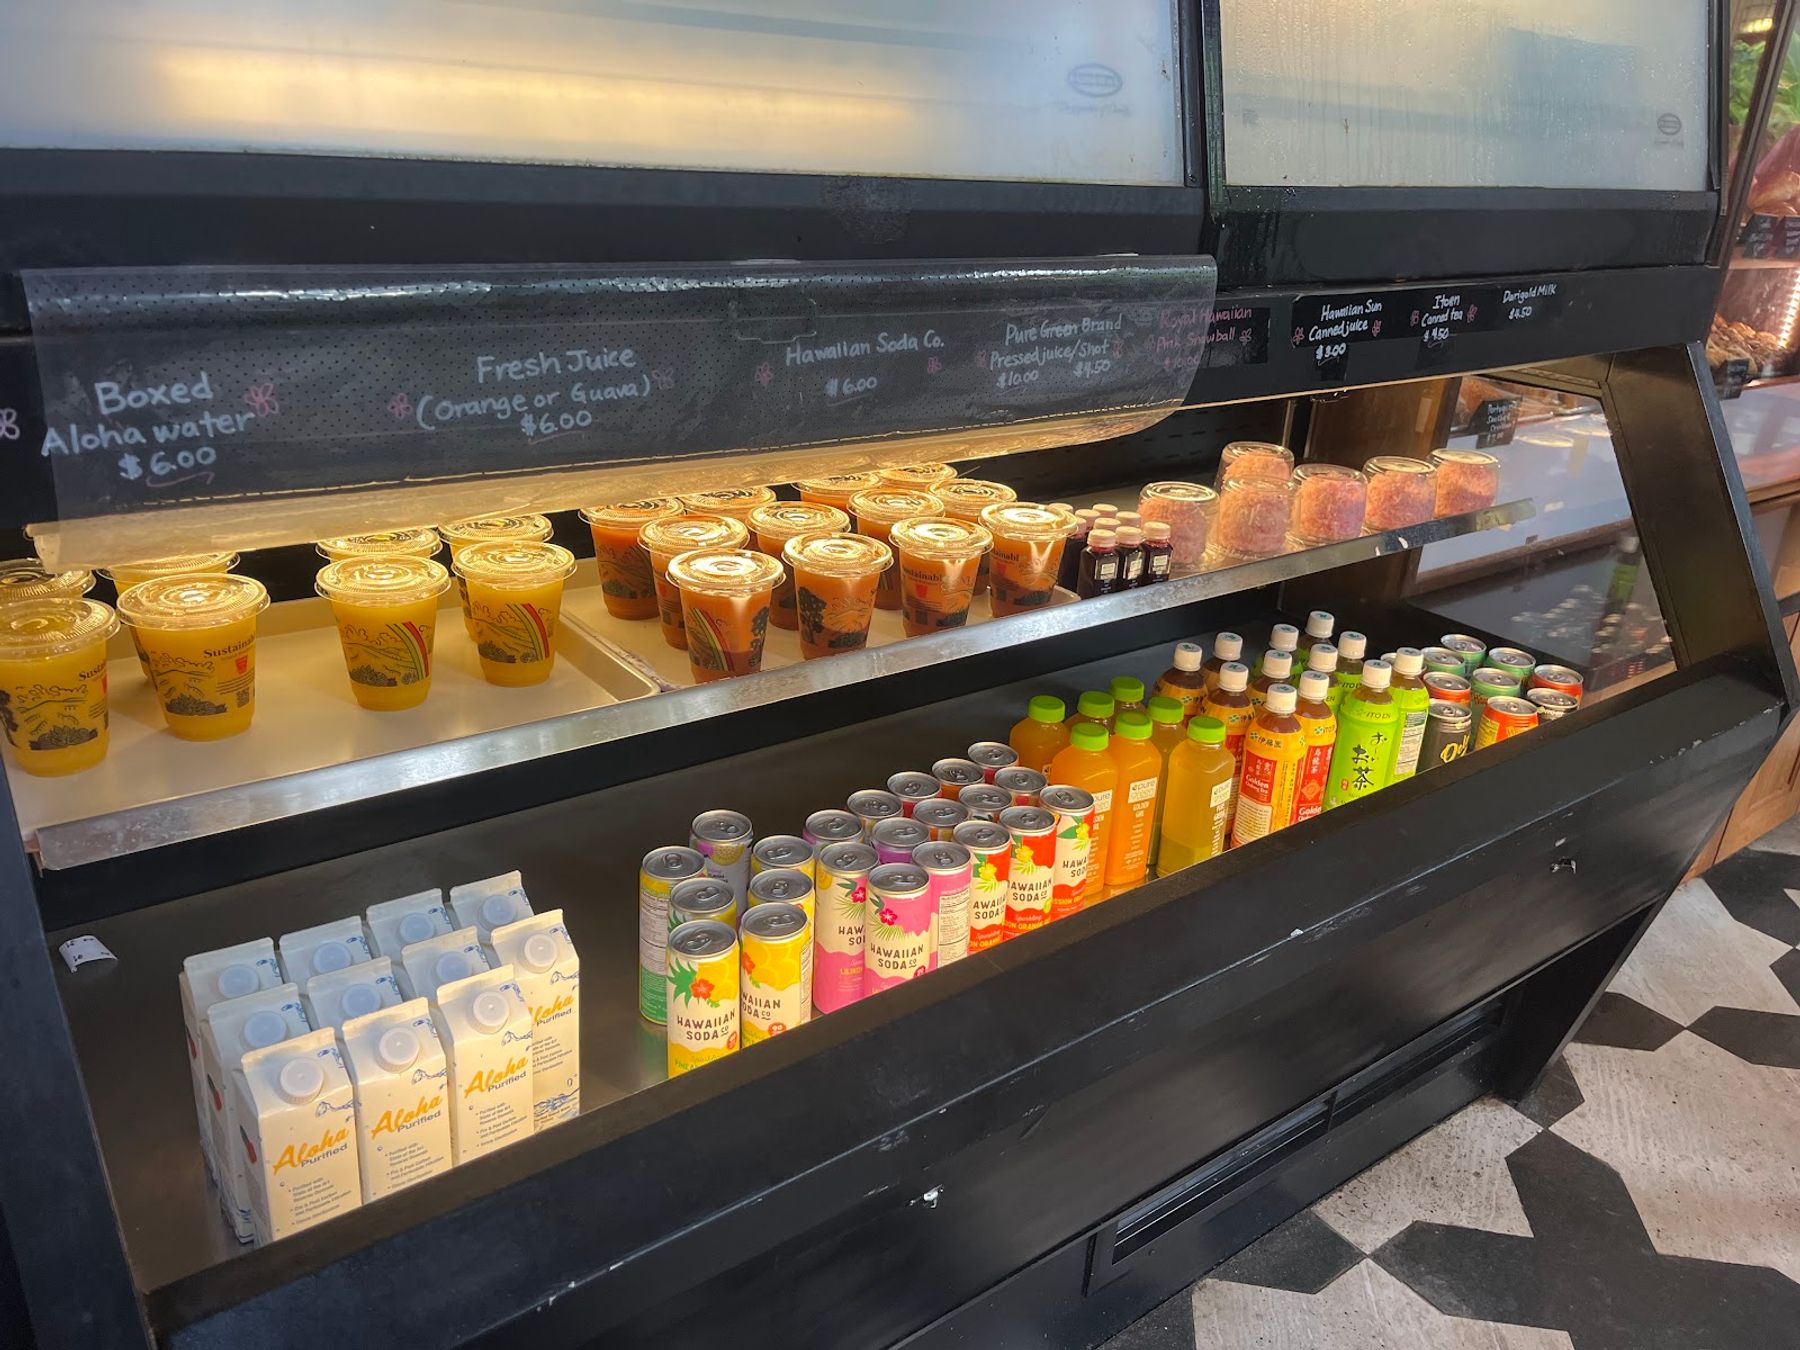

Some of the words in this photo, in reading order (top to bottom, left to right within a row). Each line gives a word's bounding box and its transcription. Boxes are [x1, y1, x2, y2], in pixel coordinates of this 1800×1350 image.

[1537, 283, 1558, 297] Milk
[1200, 304, 1252, 323] Hawaiian
[1320, 304, 1364, 321] Hawaiian
[1365, 298, 1383, 313] Sun
[1421, 311, 1449, 327] Canned
[1450, 307, 1463, 321] tea
[1508, 306, 1533, 320] $4.50
[1005, 323, 1039, 346] Pure
[1040, 319, 1078, 339] Green
[1081, 313, 1122, 332] Brand
[1187, 327, 1236, 345] Snowball
[1423, 327, 1450, 342] $4.50
[785, 341, 871, 367] Hawaiian
[876, 332, 919, 353] Soda
[923, 329, 945, 348] Co.
[476, 352, 562, 384] Fresh
[566, 347, 636, 372] Juice
[996, 370, 1039, 389] $10.00
[1073, 359, 1111, 378] $4.50
[94, 370, 214, 415] Boxed
[825, 377, 878, 398] $6.00
[416, 392, 528, 431] (Orange
[533, 392, 561, 408] or
[570, 375, 650, 404] Guava)
[41, 423, 147, 457] Aloha
[152, 410, 256, 443] water
[521, 410, 593, 436] $6.00
[118, 446, 217, 480] $6.00
[1352, 744, 1374, 790] お茶
[1012, 892, 1040, 902] SODA
[974, 908, 1000, 919] SODA
[870, 943, 924, 959] HAWAIIAN
[878, 958, 907, 969] SODA
[528, 994, 574, 1025] loha
[536, 1008, 572, 1027] Purified
[677, 1007, 735, 1030] HAWAIIAN
[686, 1030, 719, 1041] SODA
[464, 1056, 529, 1099] Aloha
[488, 1071, 527, 1093] Purified
[370, 1094, 443, 1140] Aloha
[397, 1110, 442, 1133] Purified
[272, 1127, 349, 1175] Aloha
[301, 1143, 348, 1167] Purified
